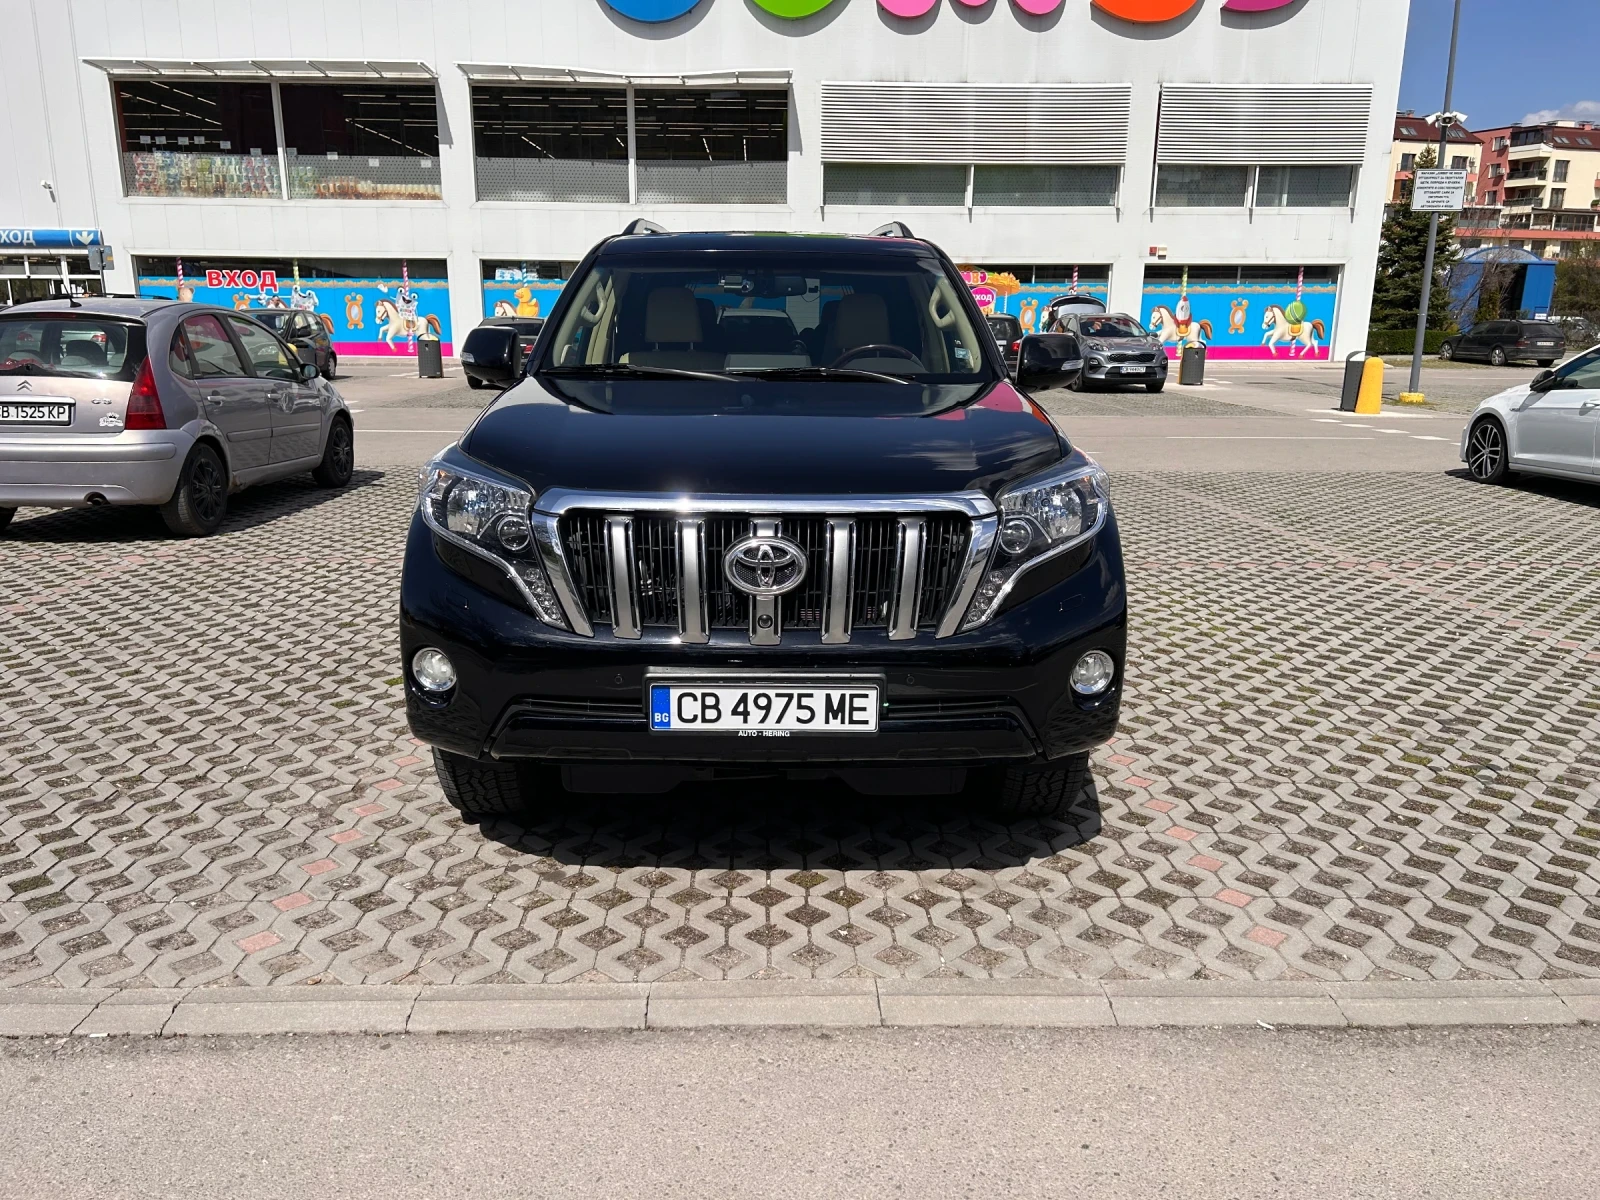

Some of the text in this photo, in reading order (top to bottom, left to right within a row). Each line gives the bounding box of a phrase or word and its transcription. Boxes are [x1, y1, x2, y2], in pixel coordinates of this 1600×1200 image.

[206, 270, 279, 293] ВХОД
[15, 406, 45, 418] 1525
[48, 406, 66, 418] KP
[654, 712, 669, 722] BG
[676, 692, 870, 725] CB 4975 ME
